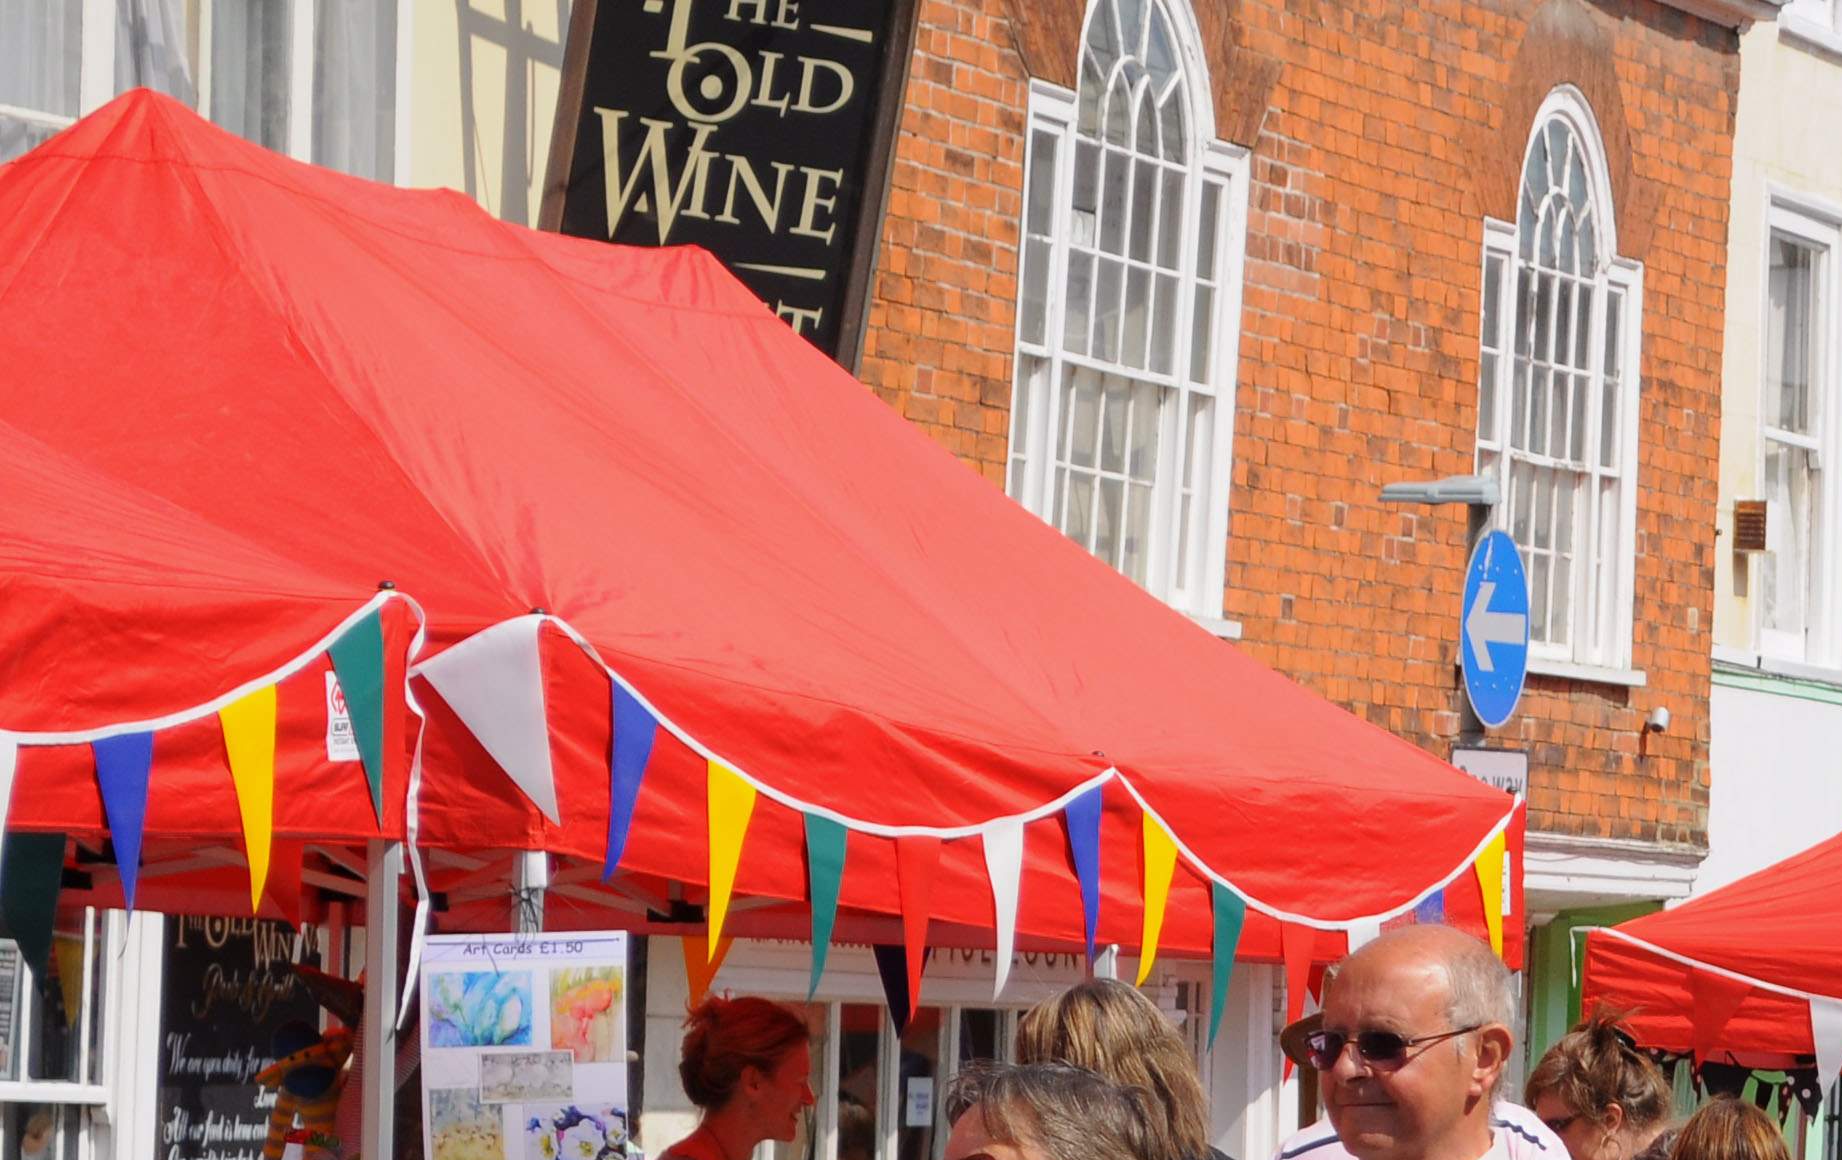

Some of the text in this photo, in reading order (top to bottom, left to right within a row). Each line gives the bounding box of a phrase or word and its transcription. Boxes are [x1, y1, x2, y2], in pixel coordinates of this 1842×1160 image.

[666, 41, 855, 123] OLD
[594, 106, 844, 246] WINE
[463, 941, 584, 956] Art Cards £1.50
